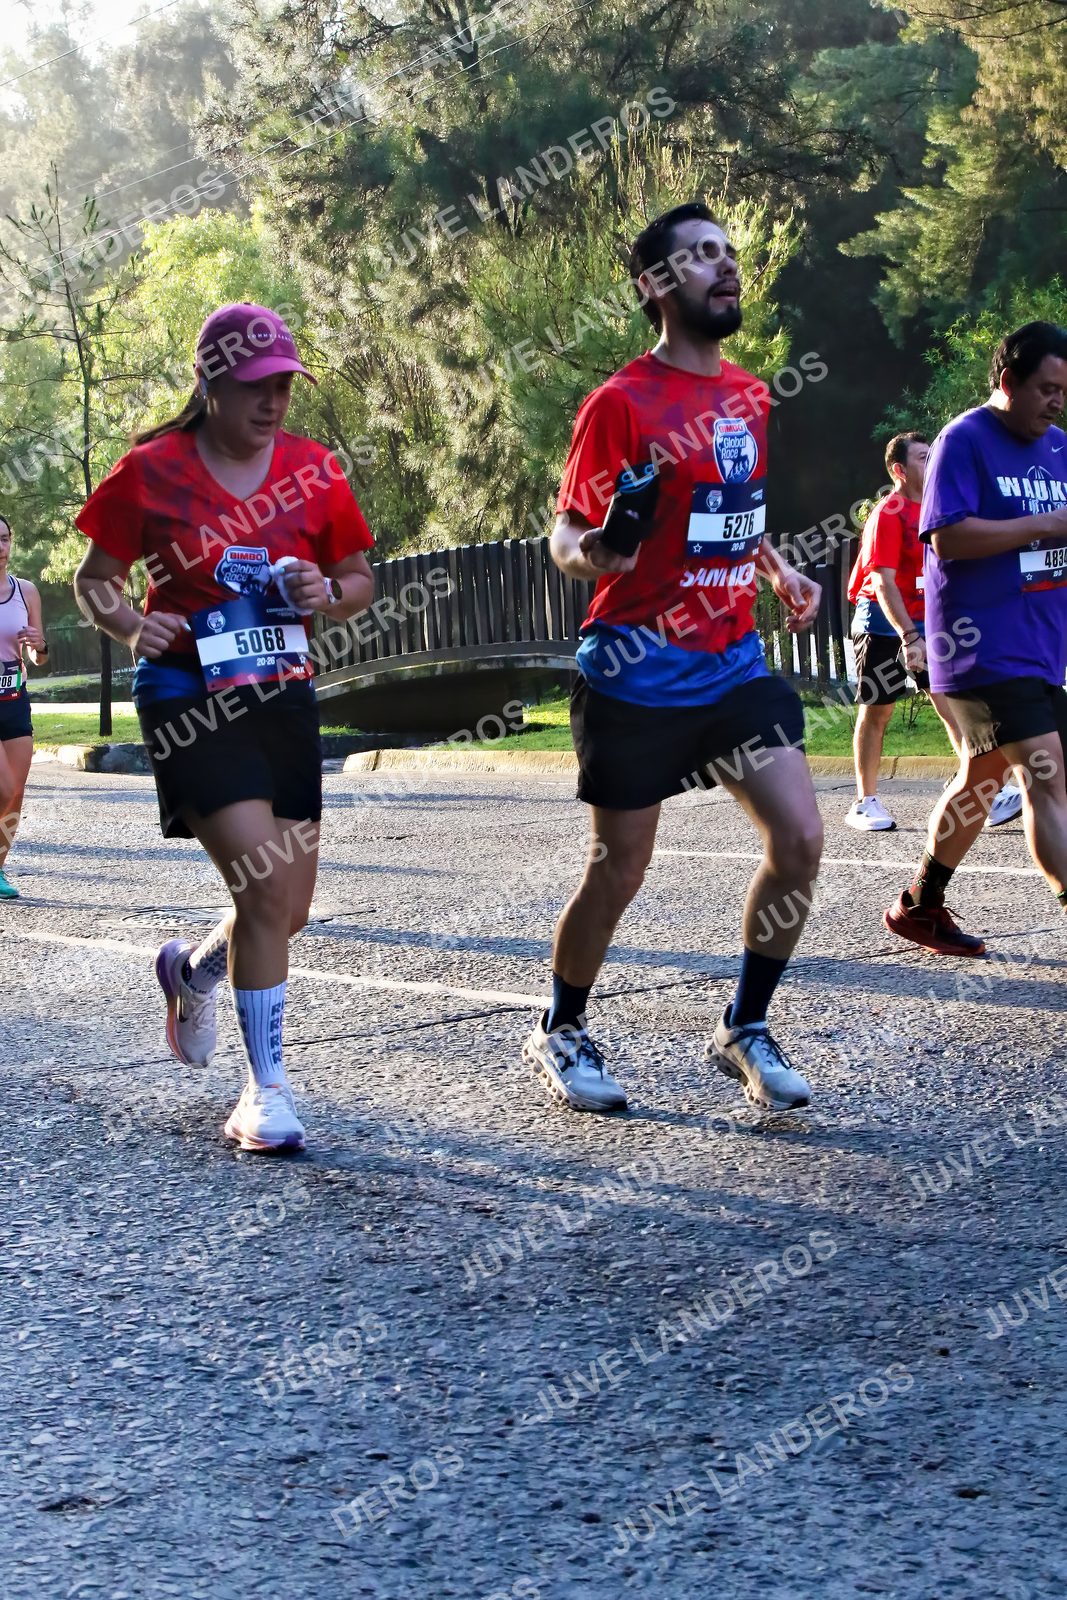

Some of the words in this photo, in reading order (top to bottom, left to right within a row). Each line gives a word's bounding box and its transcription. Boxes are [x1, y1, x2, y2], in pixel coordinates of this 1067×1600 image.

[723, 436, 746, 449] Global
[721, 447, 738, 460] Race
[722, 512, 755, 540] 5276
[229, 552, 262, 561] BIMBO
[229, 563, 262, 576] Global
[224, 573, 248, 582] Race
[234, 626, 286, 656] 5068
